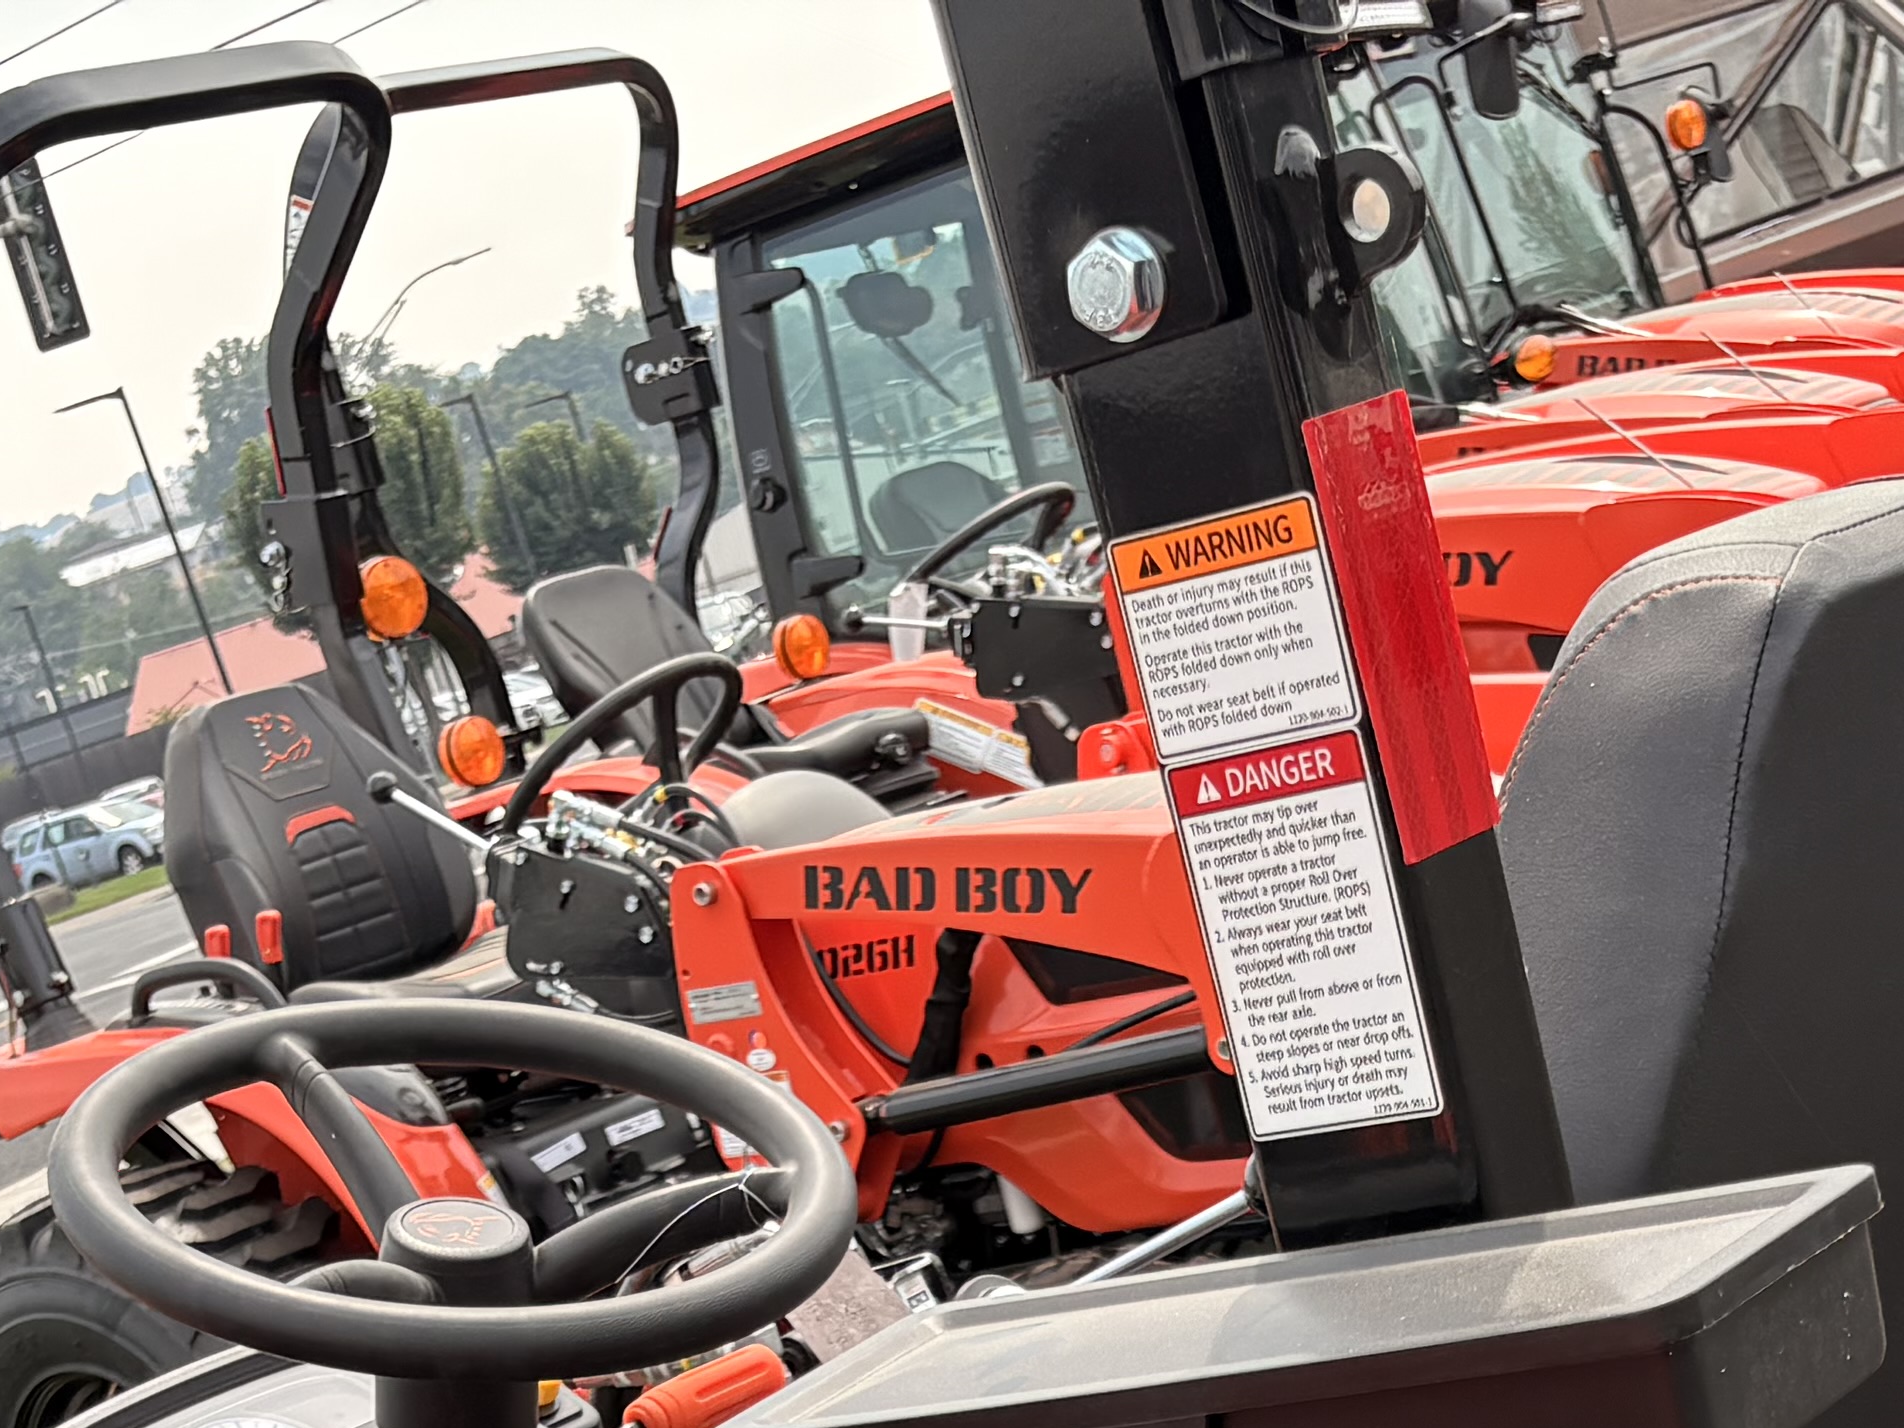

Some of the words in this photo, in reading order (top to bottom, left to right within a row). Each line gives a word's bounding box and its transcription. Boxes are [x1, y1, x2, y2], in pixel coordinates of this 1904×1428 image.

[1164, 514, 1293, 570] WARNING
[1131, 593, 1164, 613] Death
[1179, 583, 1214, 602] injury
[1216, 577, 1243, 593] may
[1243, 566, 1277, 586] result
[1289, 559, 1312, 576] this
[1443, 551, 1513, 587] OY
[1134, 610, 1172, 628] tractor
[1174, 597, 1230, 619] overturns
[1231, 588, 1258, 606] with
[1259, 585, 1279, 600] the
[1281, 575, 1314, 595] ROPS
[1151, 626, 1171, 641] the
[1172, 615, 1209, 636] folded
[1211, 610, 1244, 628] down
[1144, 648, 1188, 669] Operate
[1190, 640, 1213, 657] this
[1213, 633, 1252, 652] tractor
[1254, 625, 1282, 642] with
[1283, 621, 1303, 636] the
[1147, 664, 1179, 683] ROPS
[1180, 655, 1217, 676] folded
[1218, 650, 1252, 667] down
[1253, 643, 1279, 660] only
[1280, 637, 1313, 654] when
[1175, 703, 1195, 717] not
[1195, 698, 1223, 713] wear
[1226, 690, 1251, 707] seat
[1251, 684, 1276, 701] belt
[1288, 669, 1340, 695] operated
[1160, 720, 1186, 737] with
[1187, 713, 1219, 732] ROPS
[1220, 705, 1258, 725] folded
[1259, 700, 1292, 717] down
[1224, 749, 1335, 797] DANGER
[1189, 820, 1212, 836] This
[1212, 814, 1248, 831] tractor
[1251, 810, 1274, 824] may
[1275, 805, 1292, 821] tip
[1294, 801, 1318, 815] over
[1193, 827, 1263, 854] unexpectedly
[1264, 821, 1286, 839] and
[1288, 815, 1329, 837] quicker
[1329, 810, 1356, 826] than
[1213, 848, 1257, 868] operator
[1272, 838, 1295, 856] able
[1310, 831, 1340, 851] jump
[1341, 827, 1367, 841] free.
[1213, 871, 1244, 888] Never
[1247, 863, 1288, 883] operate
[1298, 853, 1335, 871] tractor
[1217, 884, 1259, 904] without
[1269, 878, 1305, 897] proper
[1307, 870, 1330, 887] Roll
[1331, 867, 1357, 882] Over
[804, 864, 936, 912] BAD
[954, 865, 1094, 915] BOY
[1221, 901, 1276, 921] Protection
[1227, 924, 1263, 943] Always
[1264, 919, 1290, 934] wear
[1292, 914, 1320, 933] your
[1320, 906, 1343, 924] seat
[1343, 902, 1367, 919] belt
[1229, 942, 1259, 957] when
[1261, 932, 1313, 954] operating
[1313, 926, 1335, 942] this
[1336, 920, 1372, 938] tractor
[1234, 953, 1284, 975] equipped
[1285, 949, 1310, 965] with
[1312, 944, 1331, 960] roll
[1332, 943, 1356, 957] over
[1242, 995, 1273, 1010] Never
[1275, 988, 1297, 1007] pull
[1298, 987, 1324, 1001] from
[1327, 980, 1360, 996] above
[1375, 973, 1402, 987] from
[1247, 1013, 1265, 1027] the
[1267, 1010, 1288, 1023] rear
[1268, 1028, 1287, 1043] not
[1288, 1022, 1329, 1041] operate
[1330, 1019, 1350, 1033] the
[1351, 1013, 1387, 1029] tractor
[1285, 1042, 1321, 1058] slopes
[1336, 1035, 1360, 1049] near
[1362, 1031, 1389, 1045] drop
[1260, 1064, 1290, 1082] Avoid
[1291, 1062, 1321, 1077] sharp
[1322, 1055, 1347, 1072] high
[1349, 1049, 1382, 1069] speed
[1263, 1082, 1303, 1098] Serious
[1303, 1077, 1335, 1093] injury
[1384, 1065, 1407, 1079] may
[1267, 1098, 1297, 1114] result
[1298, 1096, 1325, 1109] from
[1326, 1089, 1363, 1105] tractor
